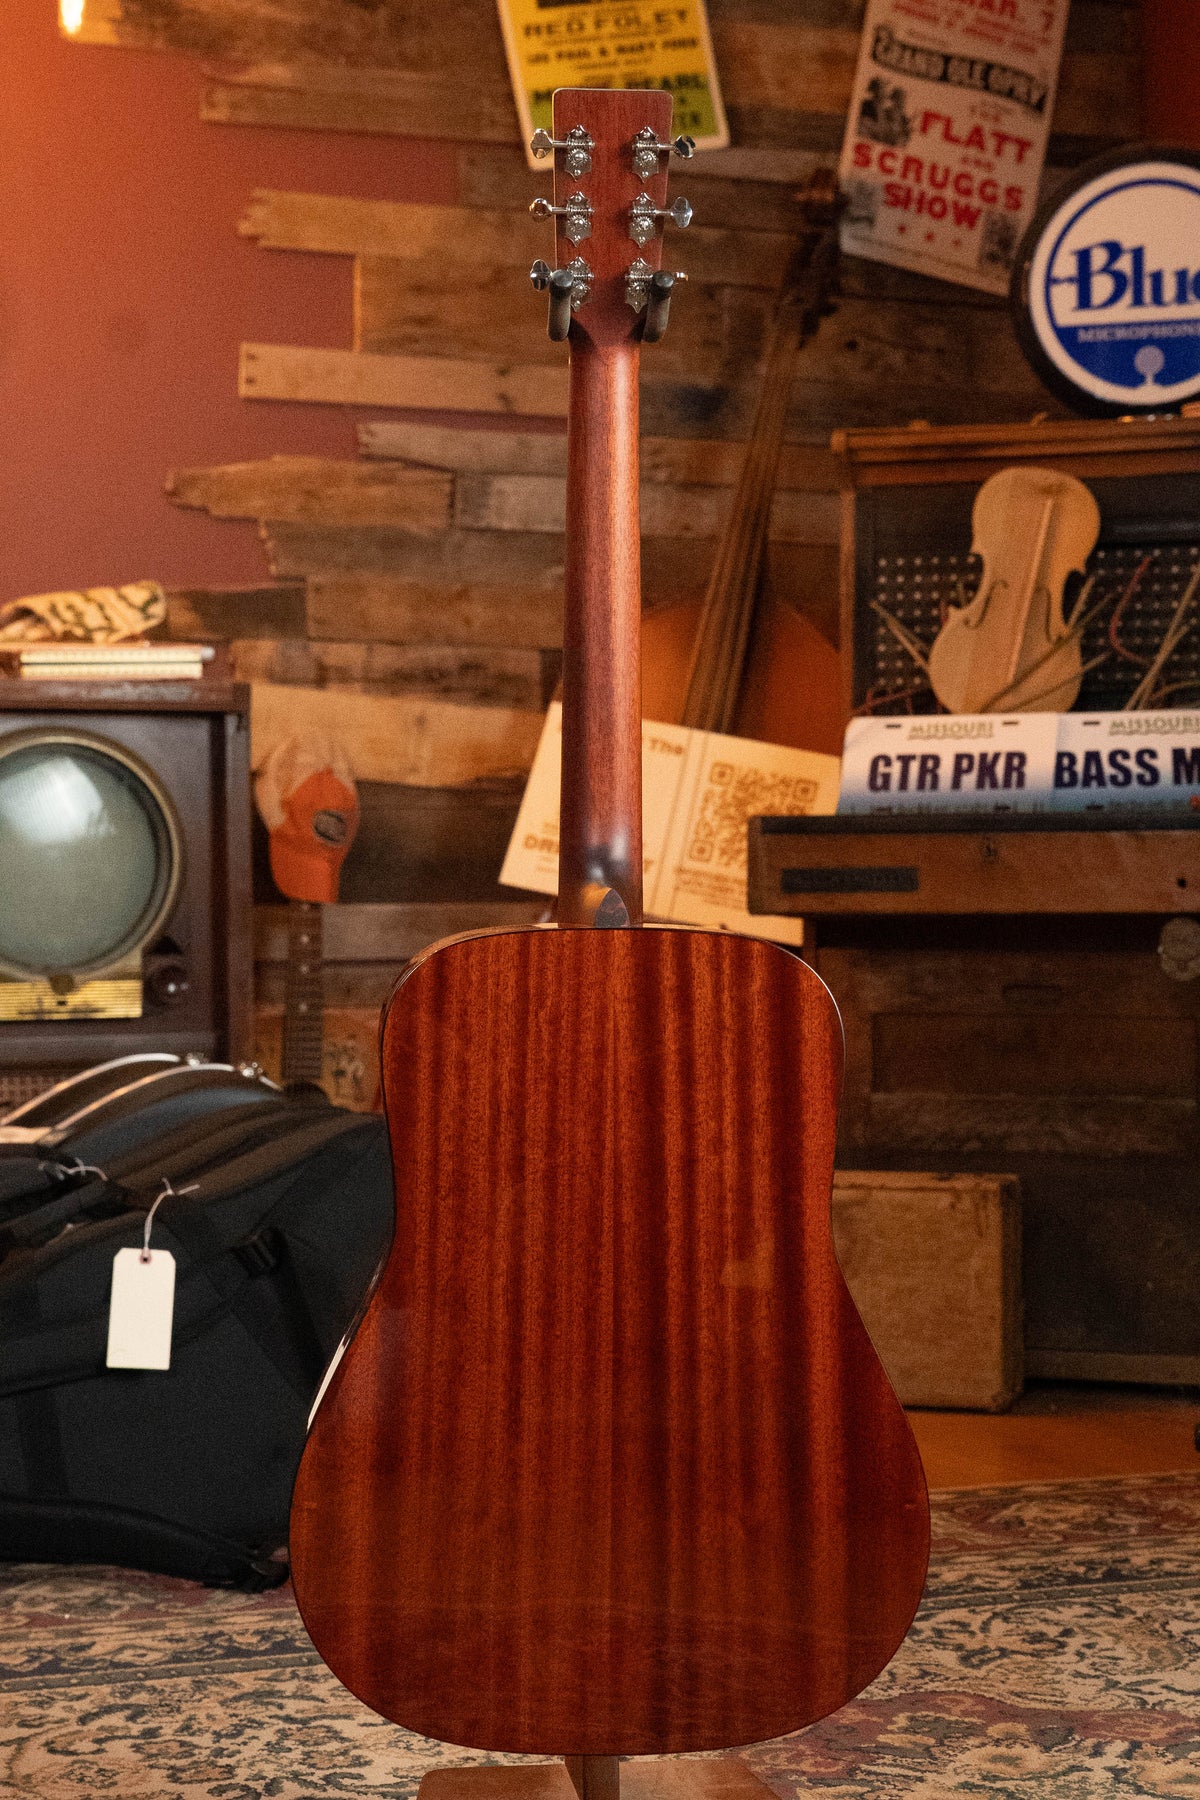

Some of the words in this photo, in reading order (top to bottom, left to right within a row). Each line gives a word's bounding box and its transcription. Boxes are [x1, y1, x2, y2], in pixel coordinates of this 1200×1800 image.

[919, 110, 1033, 165] FLATT
[852, 142, 1024, 212] SCRUGGS
[882, 182, 983, 230] SHOW
[909, 721, 994, 740] MISSOURI
[868, 753, 942, 793] GTR
[950, 751, 1028, 790] PKR
[1054, 748, 1160, 790] BASS
